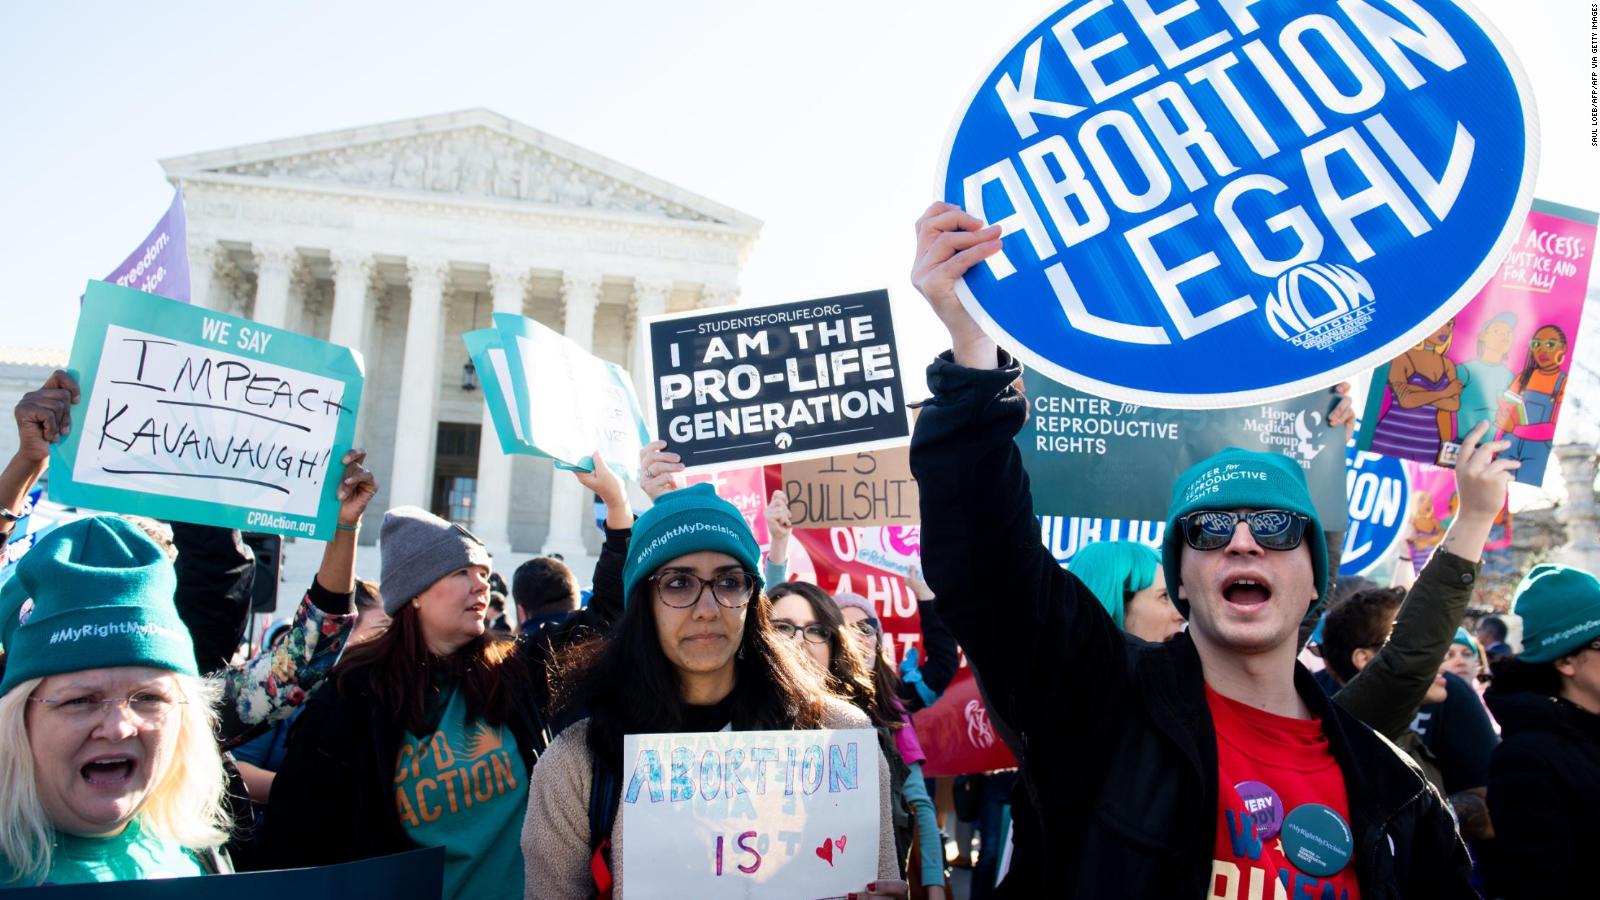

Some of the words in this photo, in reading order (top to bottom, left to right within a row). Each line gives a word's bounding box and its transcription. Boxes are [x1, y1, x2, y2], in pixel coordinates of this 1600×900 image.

[963, 0, 1467, 281] ABORTION
[1043, 112, 1475, 346] LEGAL
[1525, 229, 1586, 260] ACCESS:
[116, 232, 170, 288] Freedom.
[1504, 265, 1527, 282] FOR
[1553, 260, 1578, 278] AND
[698, 304, 842, 334] STUDENTSFORLIFE.ORG
[1265, 263, 1376, 341] NOW
[202, 317, 232, 345] WE
[237, 327, 272, 354] SAY
[670, 342, 680, 368] I
[703, 330, 770, 364] AM
[790, 315, 875, 350] THE
[1291, 306, 1377, 346] NATIONAL
[111, 338, 353, 416] IMPEACH
[660, 344, 895, 410] PRO-LIFE
[668, 386, 894, 443] GENERATION
[1034, 396, 1111, 415] CENTER
[1116, 403, 1140, 416] for
[1243, 418, 1295, 435] Medical
[1261, 406, 1296, 426] Hope
[98, 398, 331, 485] KAVANAUGH!
[1036, 416, 1178, 440] REPRODUCTIVE
[1036, 435, 1106, 455] RIGHTS
[1260, 431, 1298, 451] Group
[1225, 464, 1240, 472] for
[247, 511, 316, 536] CPDAction.org
[785, 480, 917, 526] BULLSHI
[637, 522, 741, 564] #MyRightMyDecision
[394, 731, 455, 783] CPD
[624, 742, 859, 804] ABORTION
[396, 752, 517, 826] ACTION
[717, 831, 761, 876] IS
